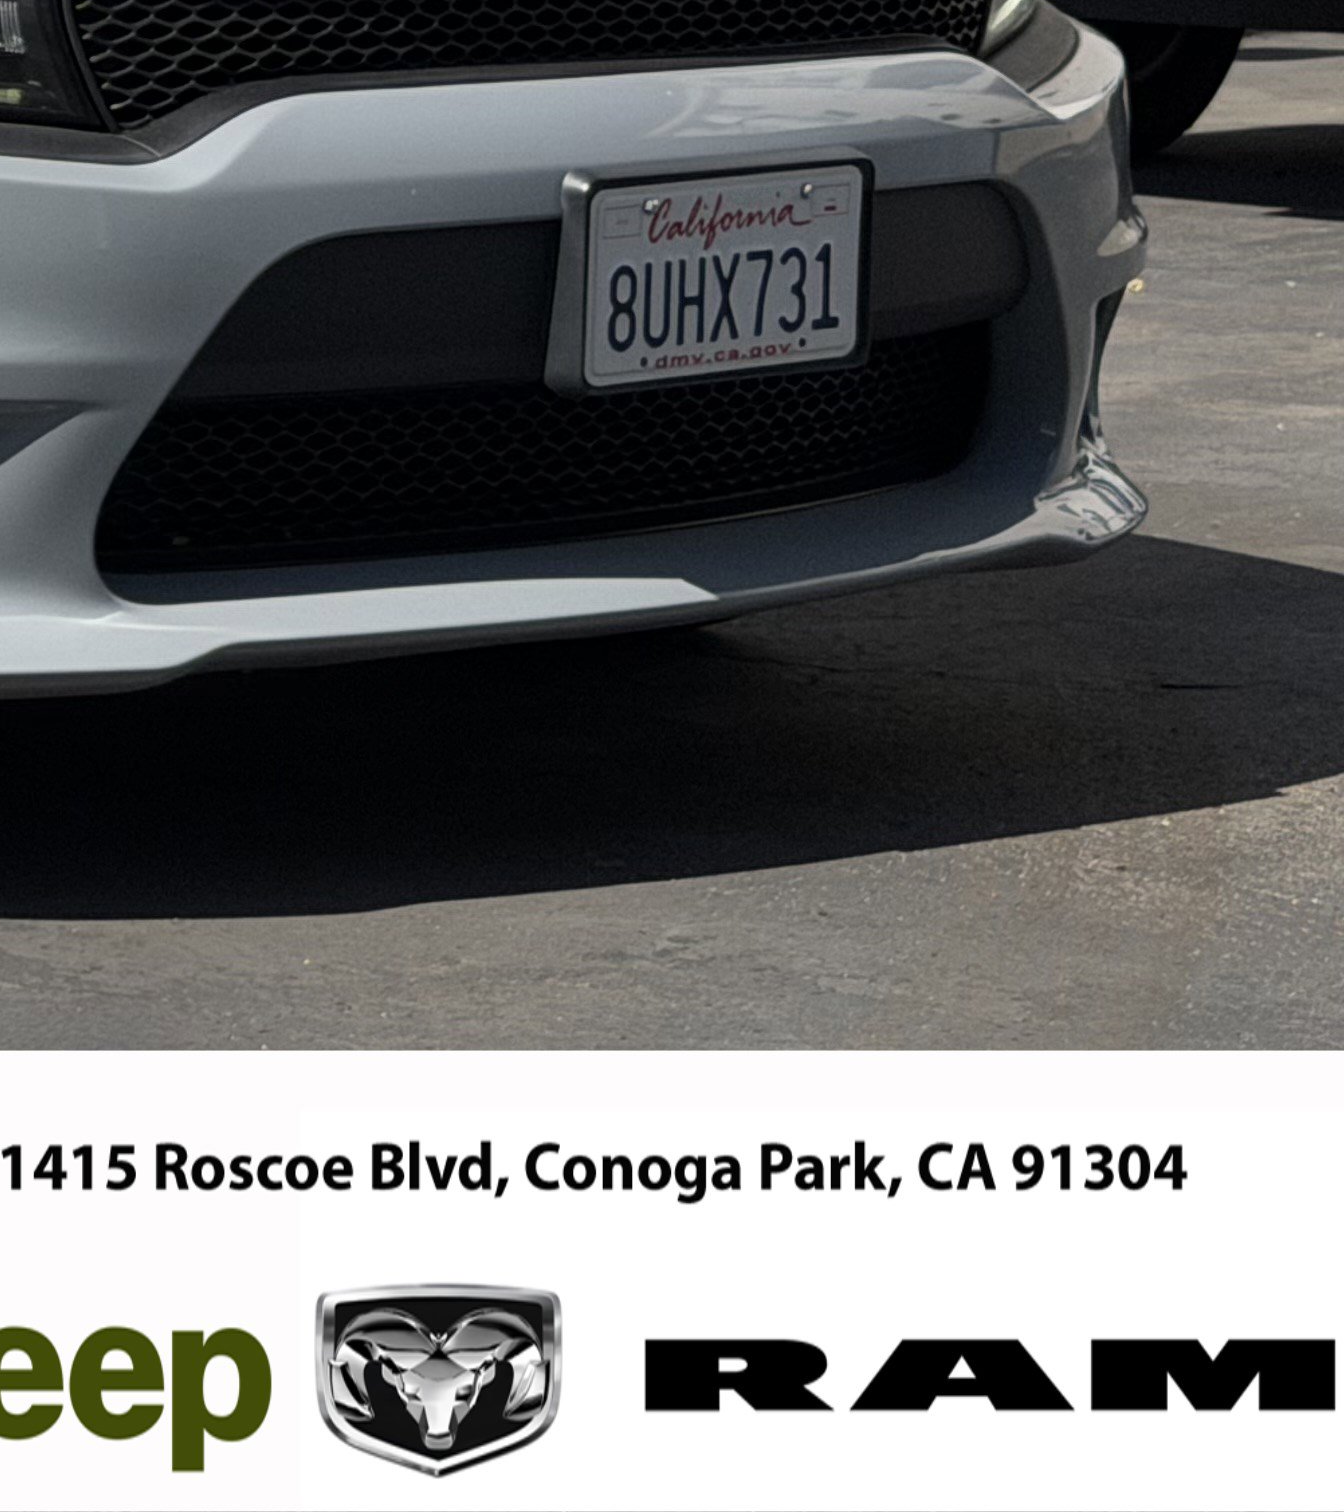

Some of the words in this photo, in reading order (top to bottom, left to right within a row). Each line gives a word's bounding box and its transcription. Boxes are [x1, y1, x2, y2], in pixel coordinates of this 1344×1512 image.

[647, 193, 812, 251] California
[607, 242, 840, 353] 8UHX731
[654, 341, 792, 370] dmv.ca.gov
